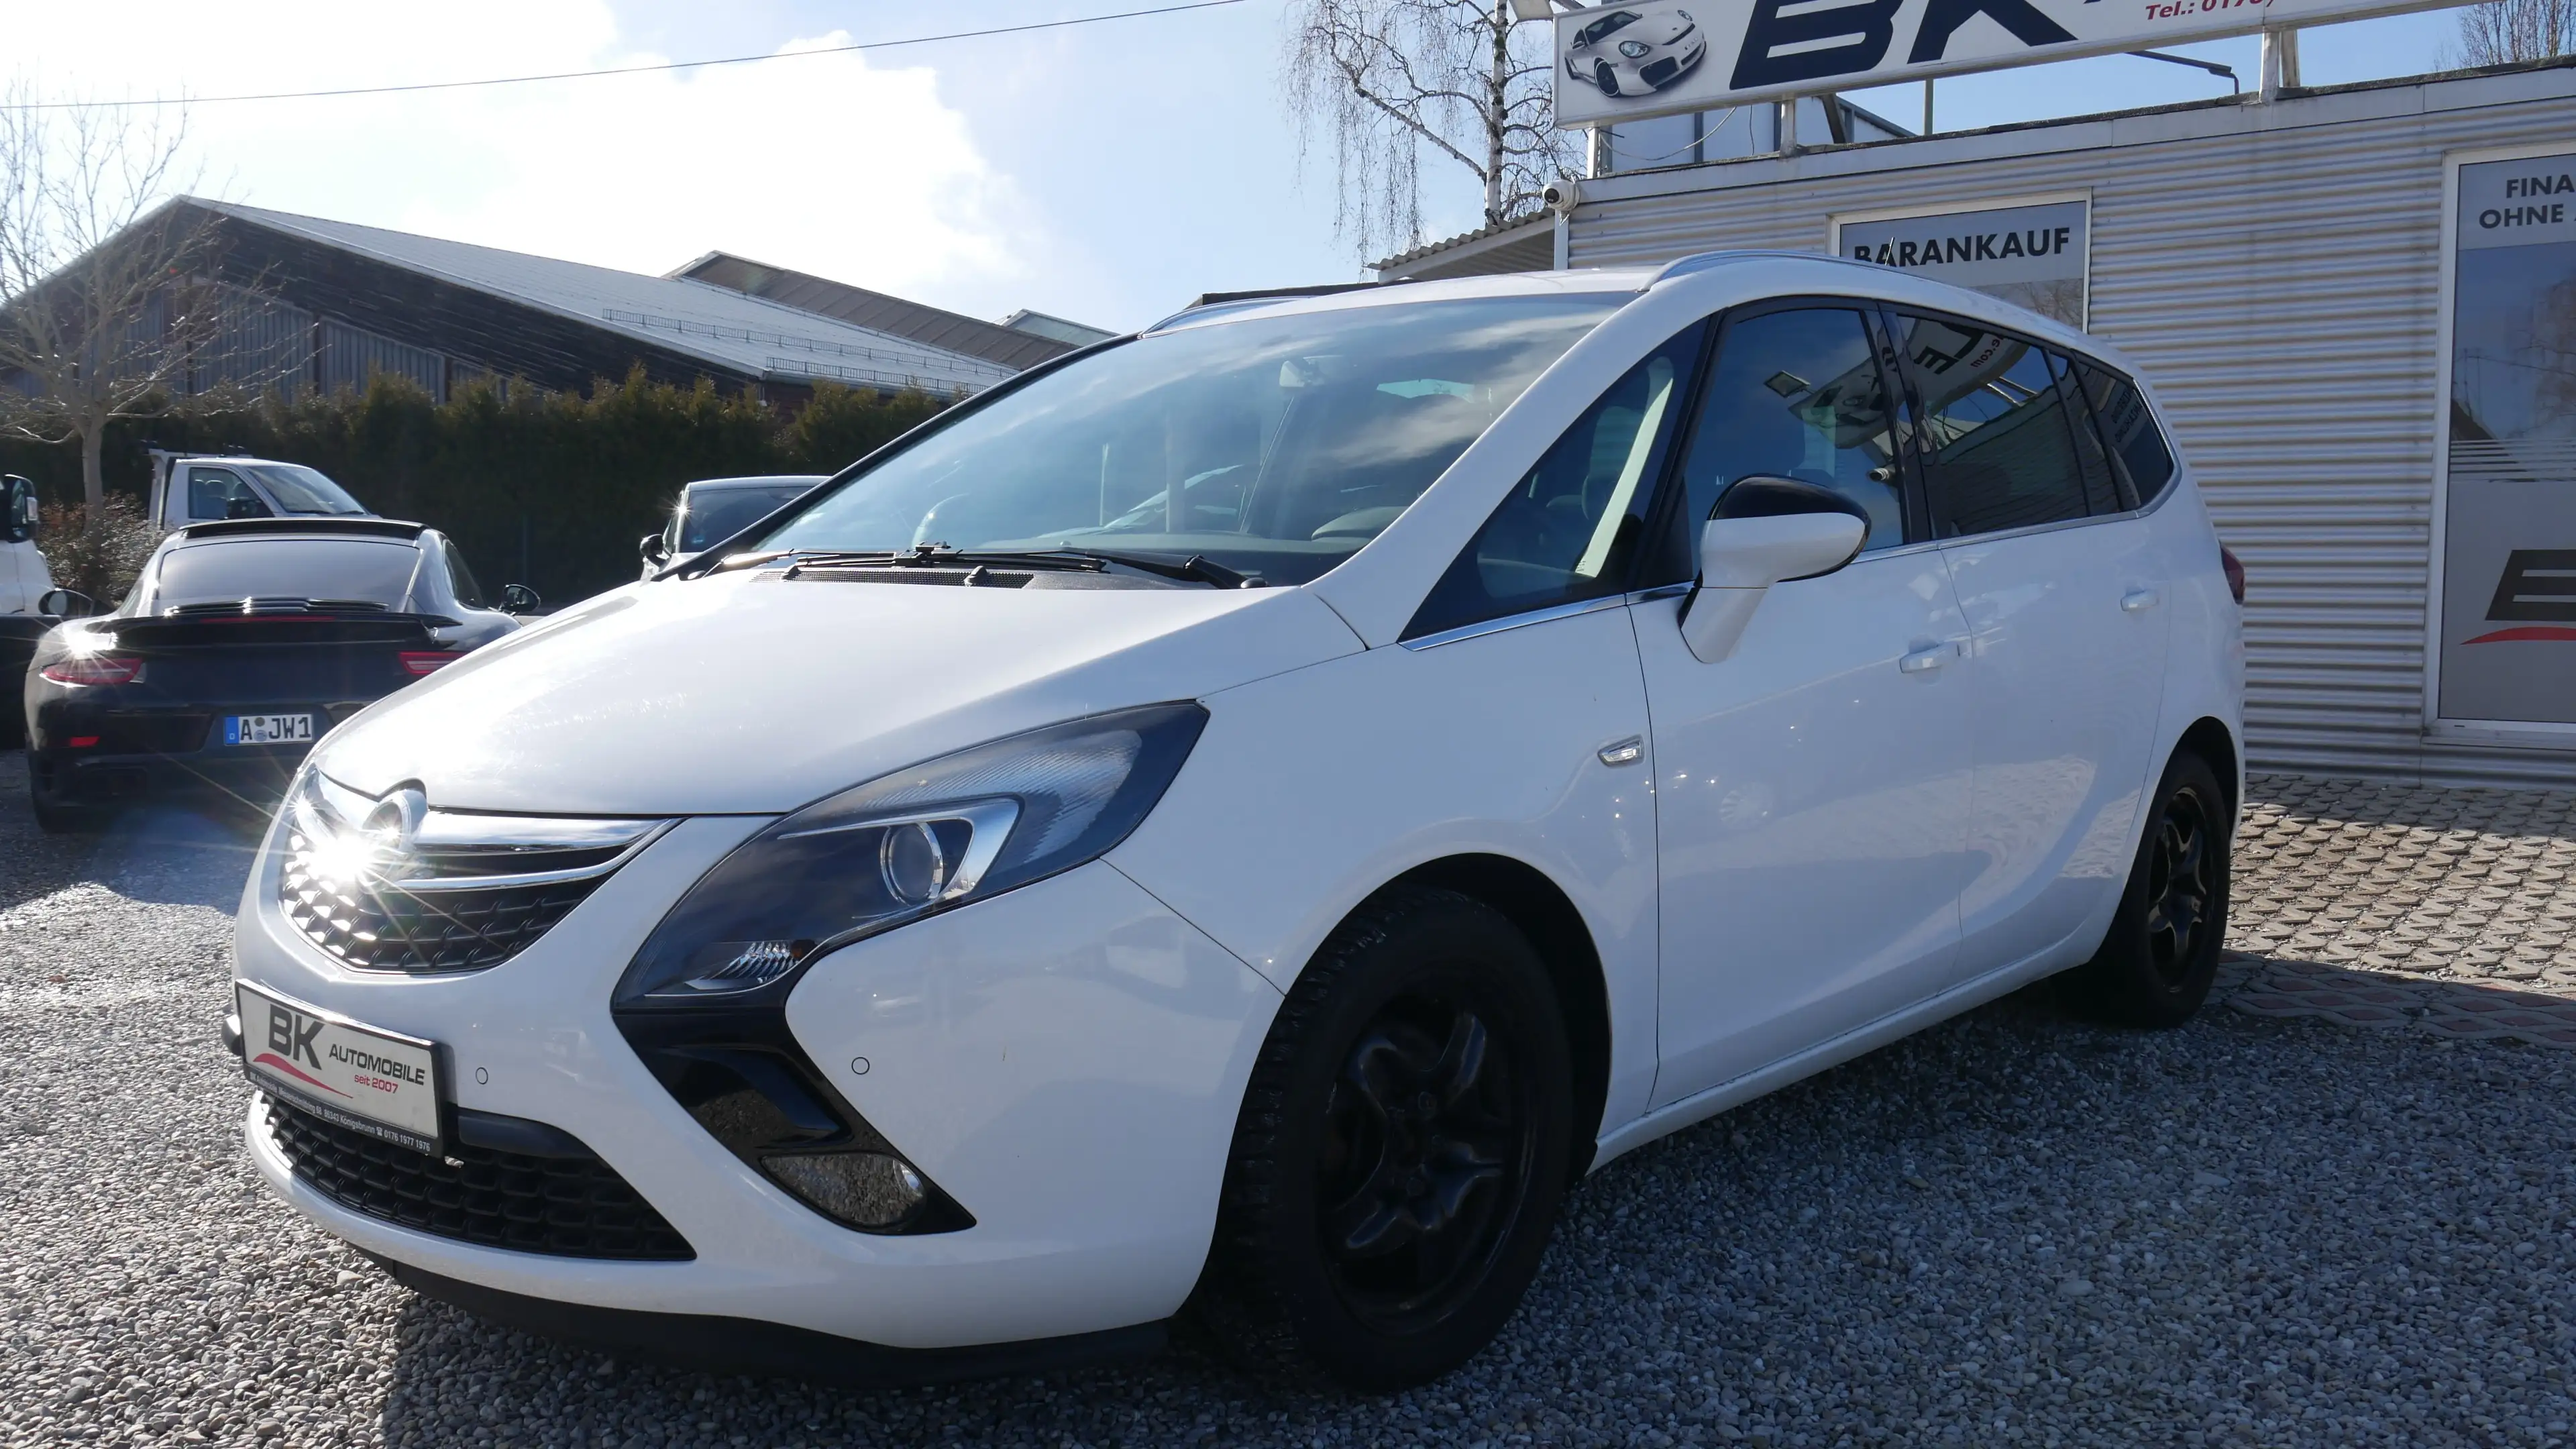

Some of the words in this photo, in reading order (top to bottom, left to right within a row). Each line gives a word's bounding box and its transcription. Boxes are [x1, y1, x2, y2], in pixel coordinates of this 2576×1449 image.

[2146, 1, 2194, 20] Tel.:
[2506, 174, 2575, 199] FINA
[2479, 204, 2563, 229] OHNE
[1854, 227, 2070, 267] BARANKAUF
[240, 719, 252, 741] A
[269, 1004, 325, 1071] BK
[329, 1044, 425, 1085] AUTOMOBILE
[354, 1073, 370, 1086] seit
[372, 1077, 398, 1094] 2007
[384, 1130, 398, 1142] 0176
[399, 1134, 414, 1146] 1977
[416, 1138, 431, 1152] 1976
